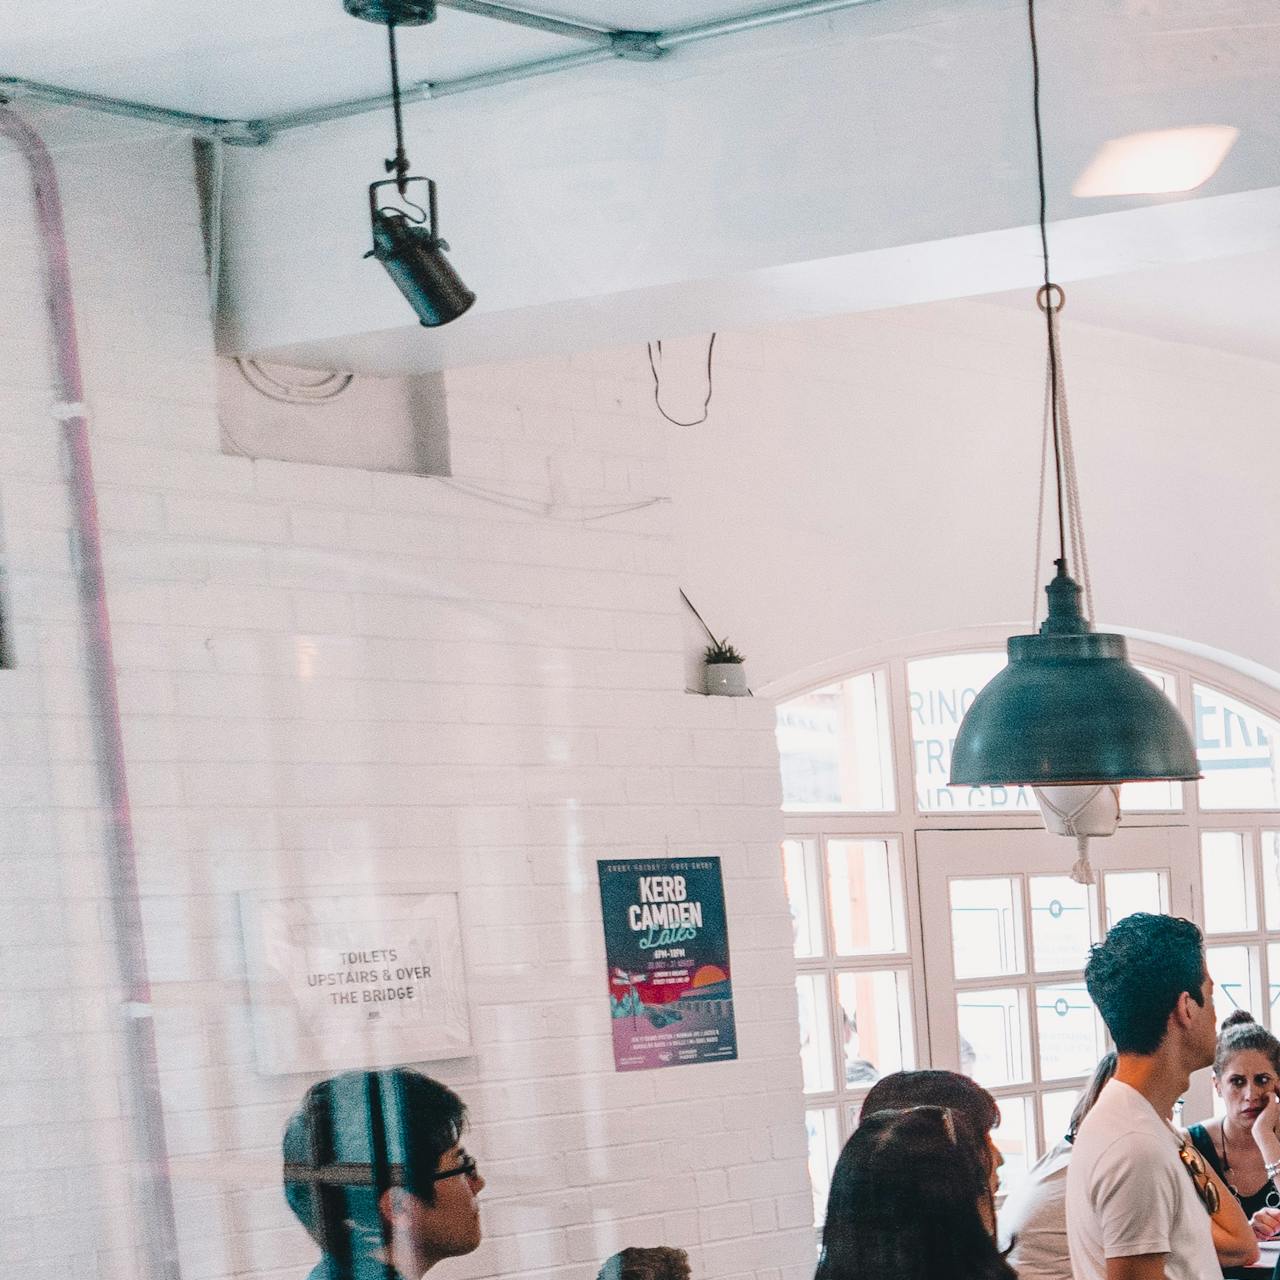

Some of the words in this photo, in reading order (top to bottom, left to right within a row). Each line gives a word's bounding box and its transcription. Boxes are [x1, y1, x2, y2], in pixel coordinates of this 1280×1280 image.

[638, 875, 687, 903] KERB
[628, 902, 703, 931] CAMDEN
[339, 948, 399, 966] TOILETS
[306, 969, 379, 988] UPSTAIRS
[381, 968, 393, 982] &
[395, 965, 433, 982] OVER
[329, 990, 359, 1005] THE
[361, 986, 415, 1003] BRIDGE
